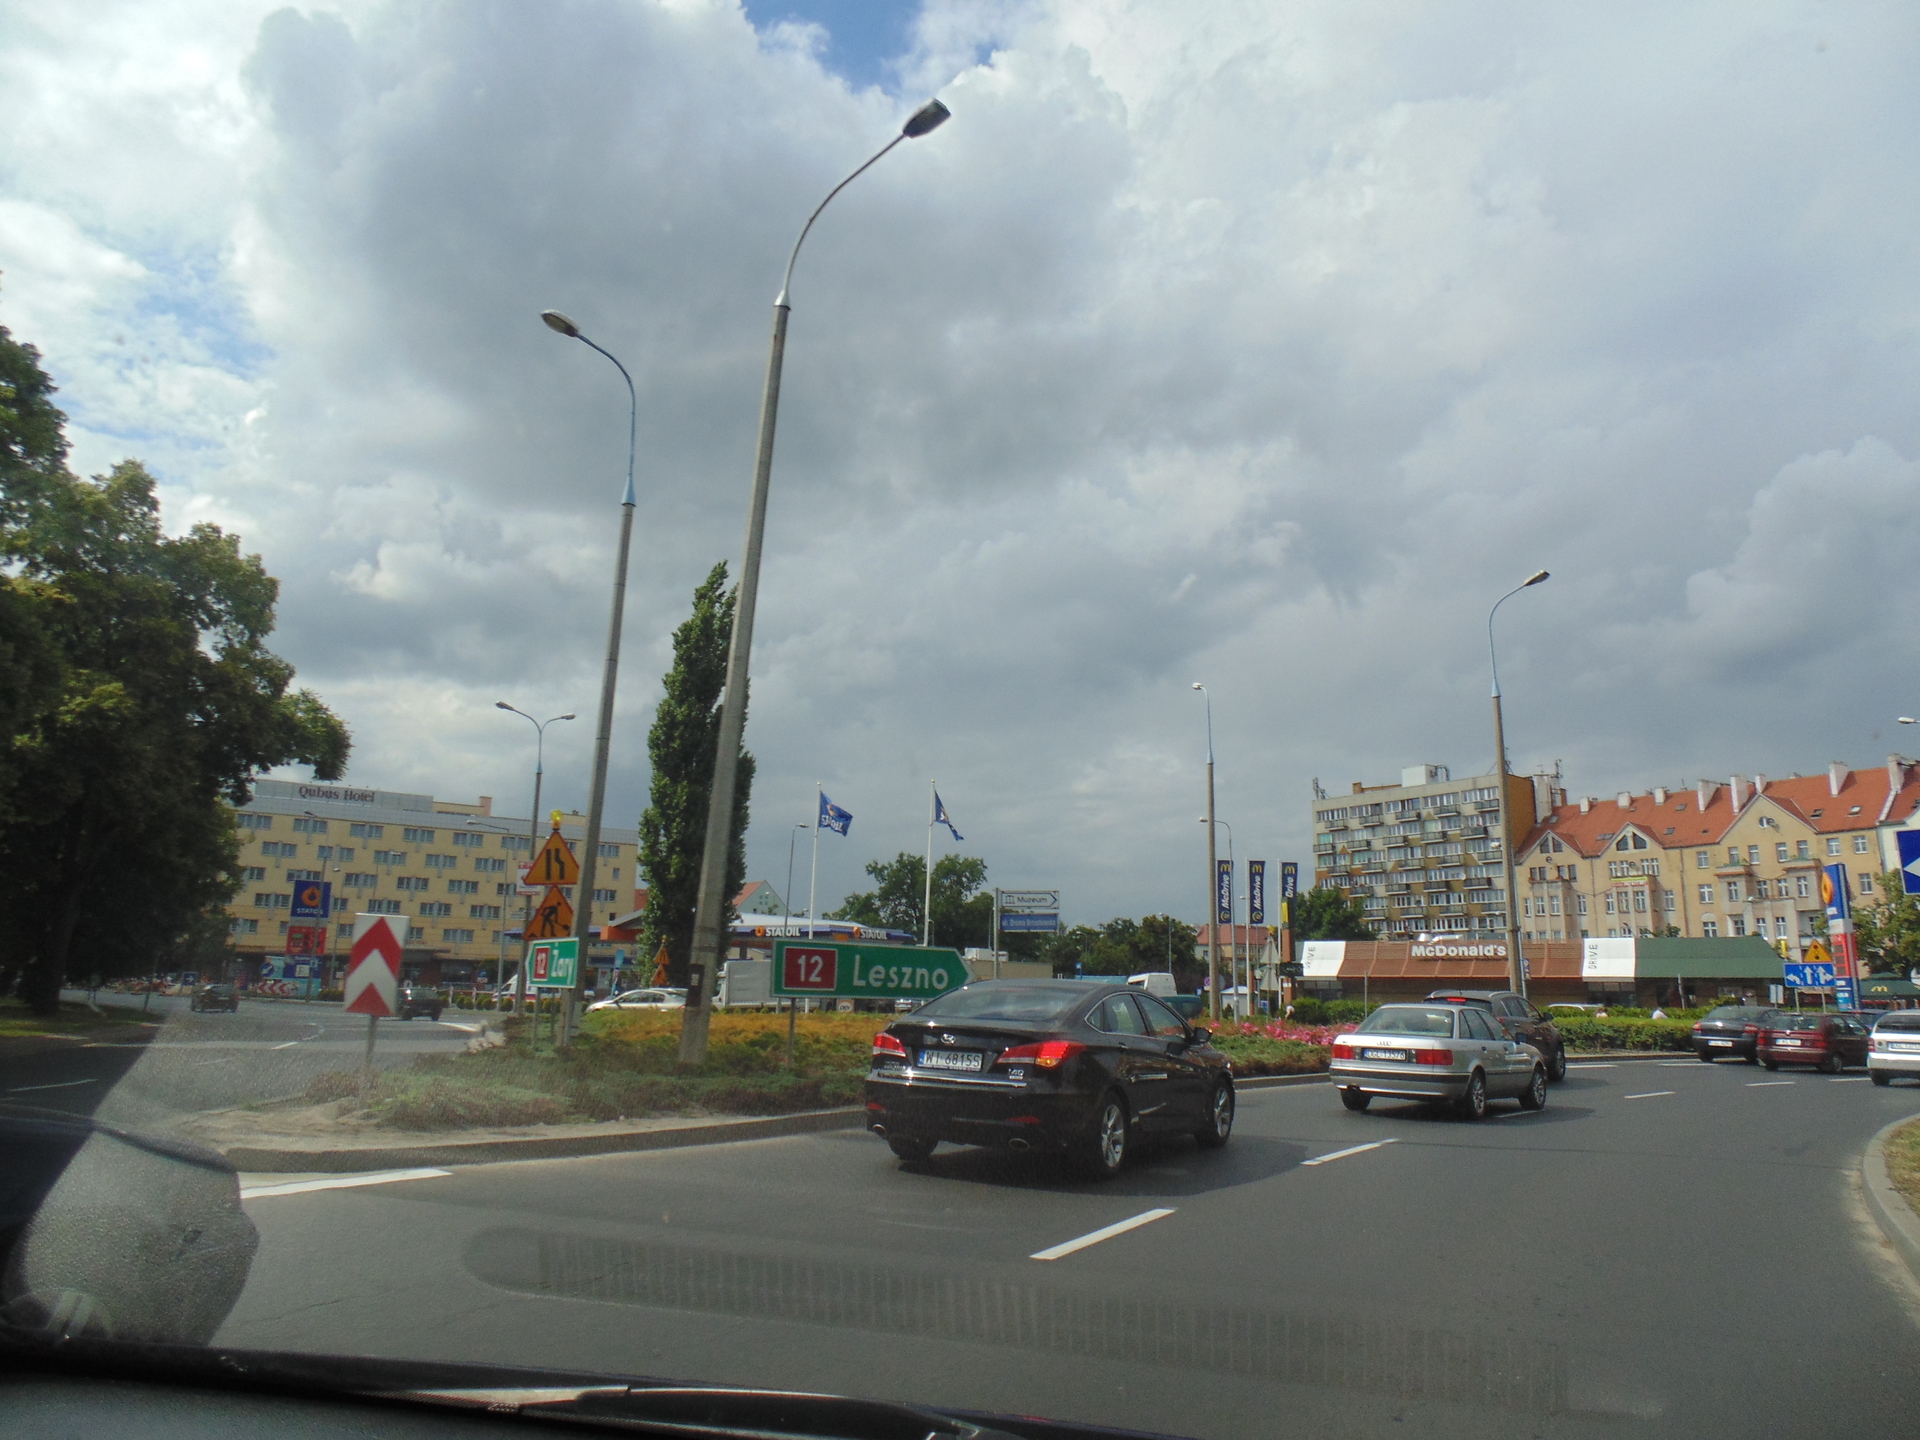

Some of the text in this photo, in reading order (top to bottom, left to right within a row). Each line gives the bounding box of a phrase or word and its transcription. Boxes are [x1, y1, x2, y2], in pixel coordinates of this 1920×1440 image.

[298, 785, 376, 803] Qubus Hotel
[1220, 873, 1230, 910] McDrive
[1252, 874, 1261, 910] McDrive
[1284, 875, 1294, 899] Drive
[1016, 895, 1048, 904] Muzeum
[296, 906, 324, 916] STATOL
[765, 926, 801, 938] STATOIL
[860, 928, 888, 940] STATOIL
[1411, 944, 1507, 957] McDonald's
[1587, 944, 1598, 970] DRIVE
[536, 952, 549, 976] 12
[797, 953, 950, 991] 12 Leszno
[925, 1051, 940, 1064] WI
